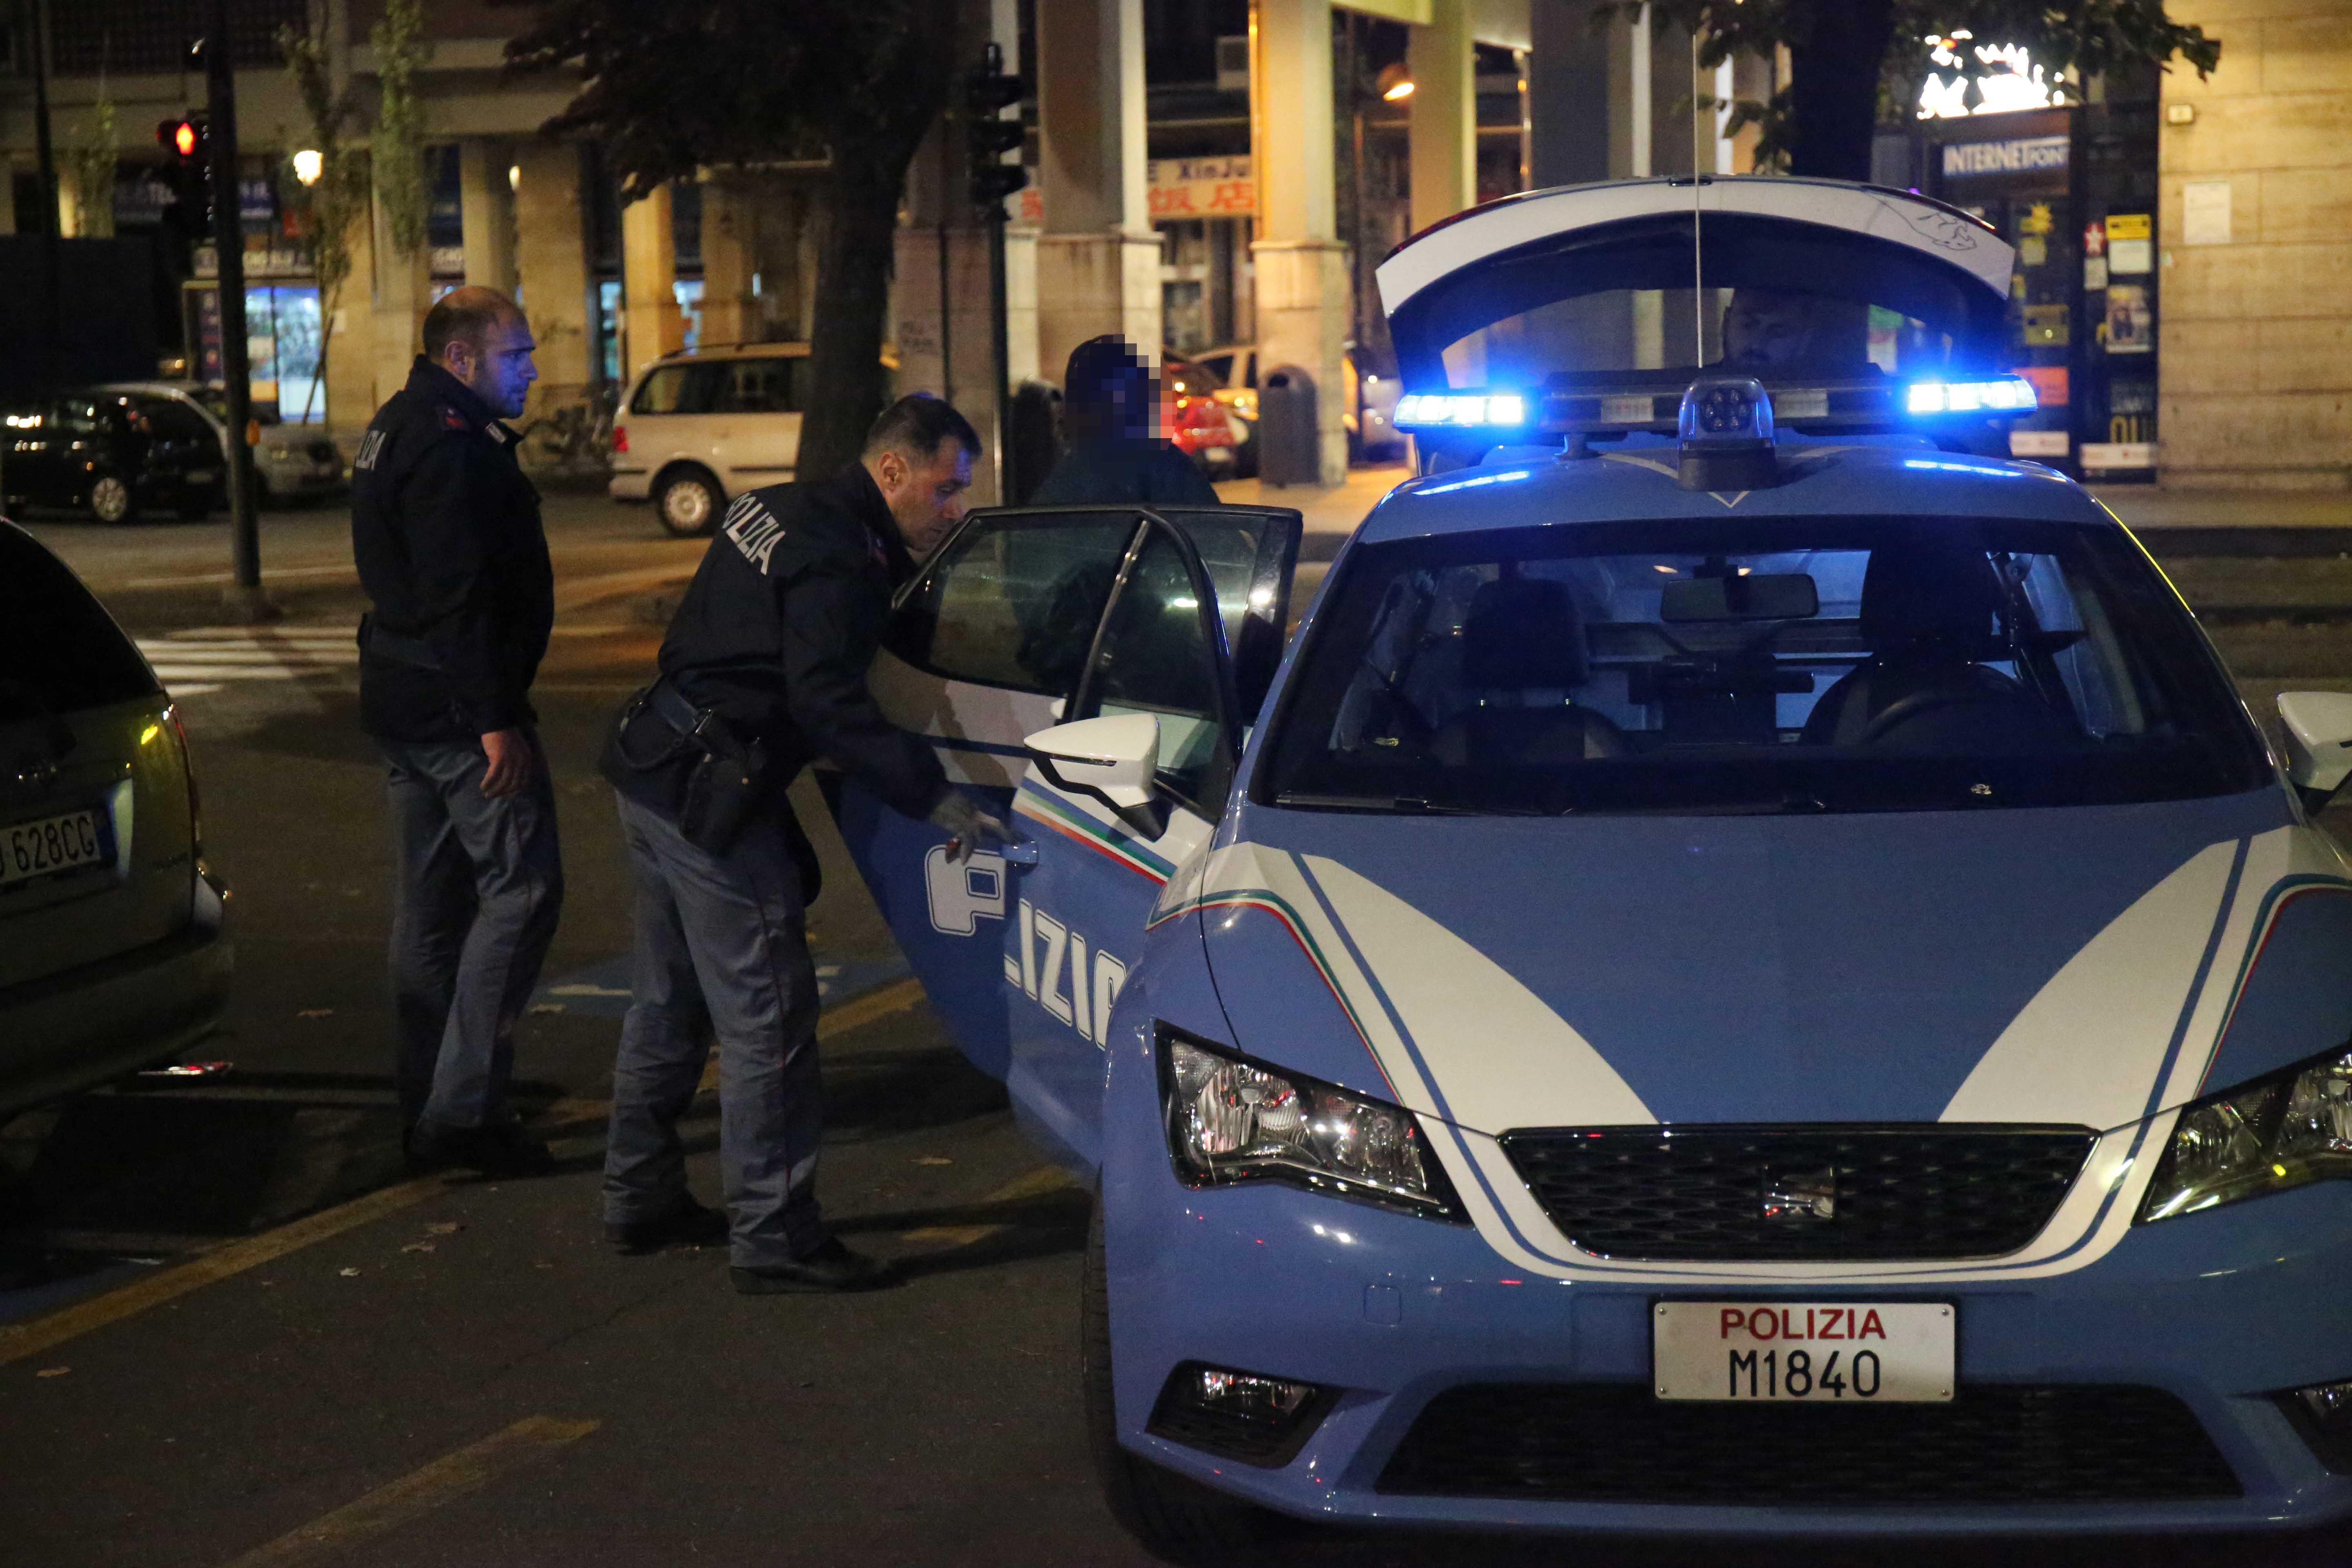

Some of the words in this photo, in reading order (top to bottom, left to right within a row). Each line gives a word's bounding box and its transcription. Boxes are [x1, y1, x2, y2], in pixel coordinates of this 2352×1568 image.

[11, 815, 95, 872] 628CG
[1720, 1309, 1887, 1340] POLIZIA
[1729, 1350, 1880, 1397] M1840
